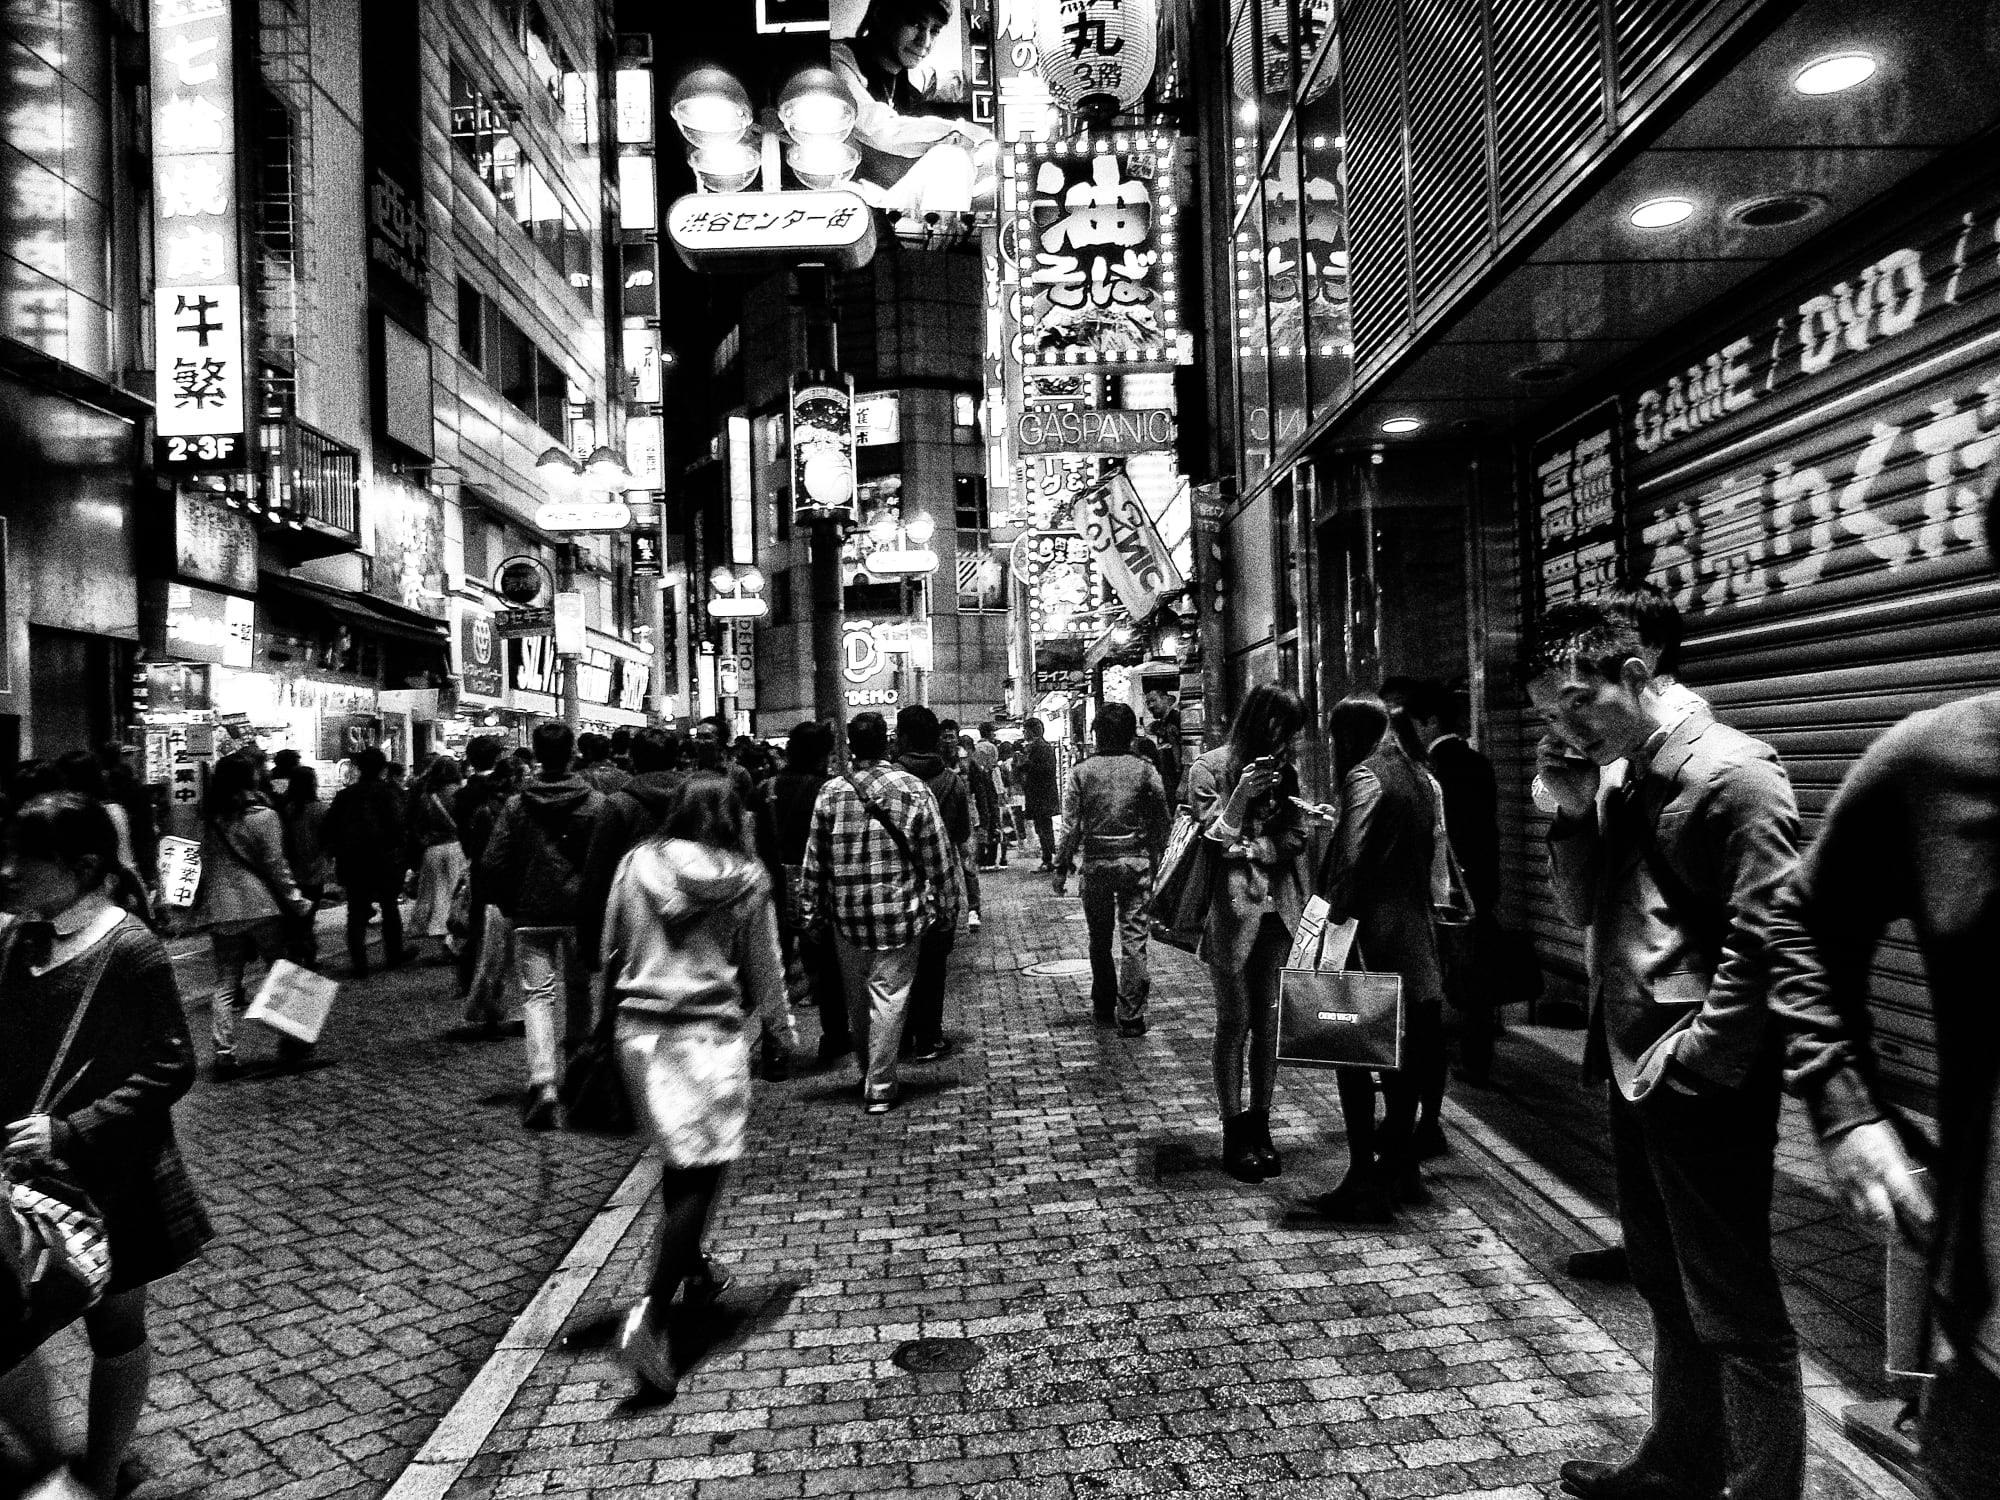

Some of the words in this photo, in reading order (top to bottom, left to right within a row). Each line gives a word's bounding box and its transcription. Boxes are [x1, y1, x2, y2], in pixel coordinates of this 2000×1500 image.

[680, 208, 859, 233] 渋谷センター街
[172, 294, 227, 410] 牛繁
[1634, 335, 1755, 454] GAME
[1799, 248, 1927, 375] DVD
